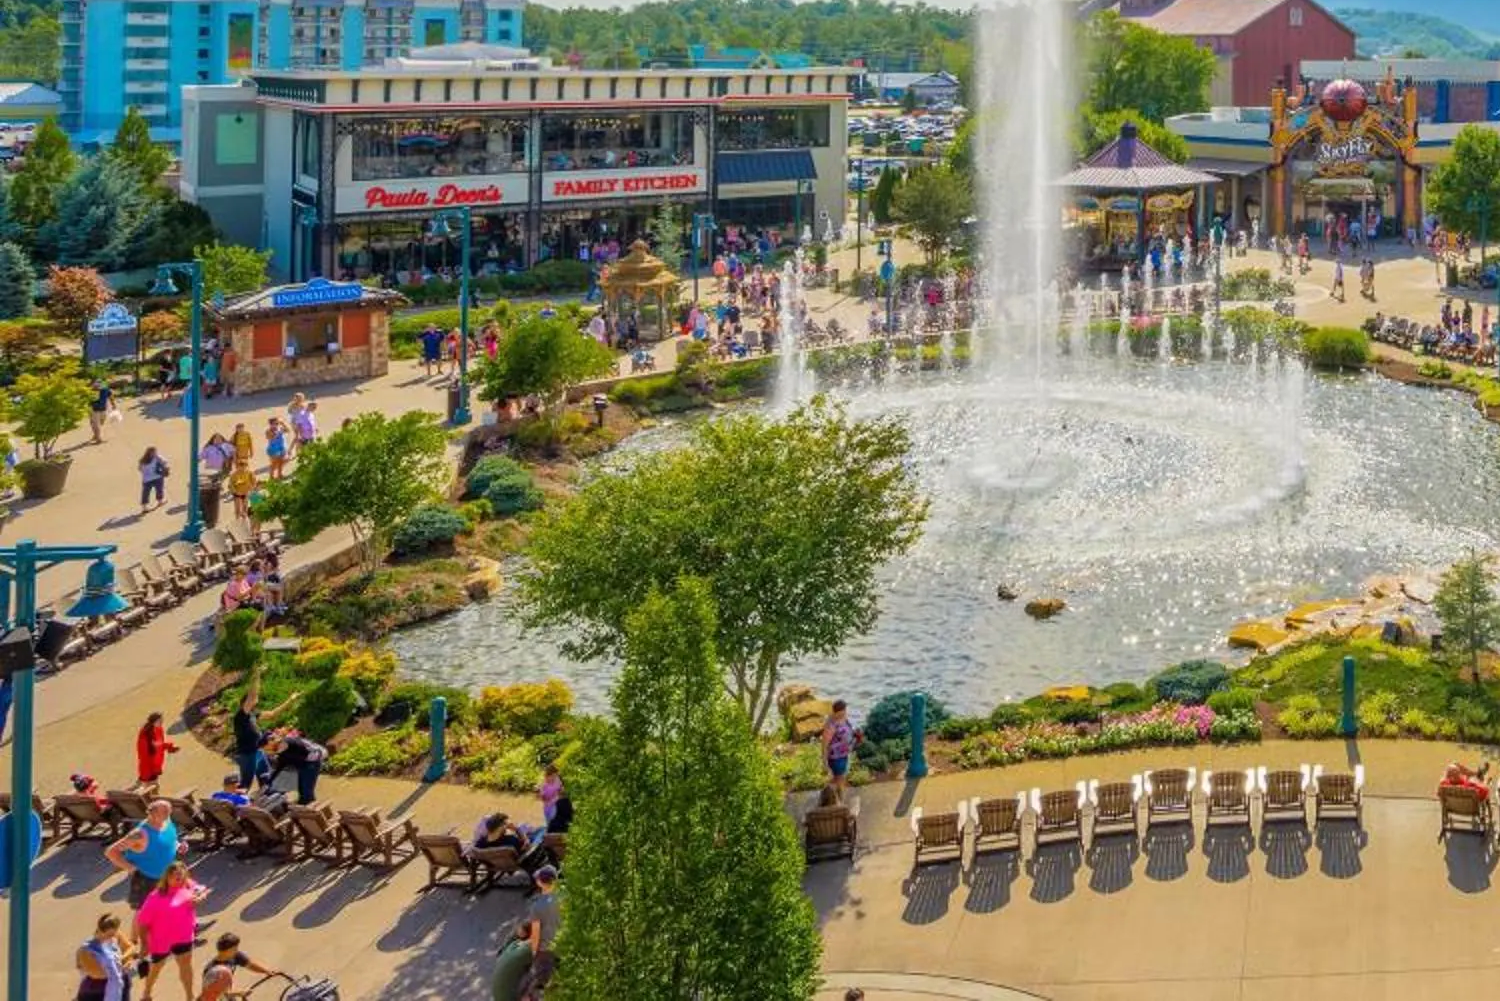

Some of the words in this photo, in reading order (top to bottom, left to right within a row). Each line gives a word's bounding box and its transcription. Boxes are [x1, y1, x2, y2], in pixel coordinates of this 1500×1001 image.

[365, 186, 429, 209] Paula
[433, 183, 503, 206] Deen's
[553, 179, 619, 197] FAMILY
[623, 173, 698, 192] KITCHEN
[276, 286, 361, 306] INFORMATION
